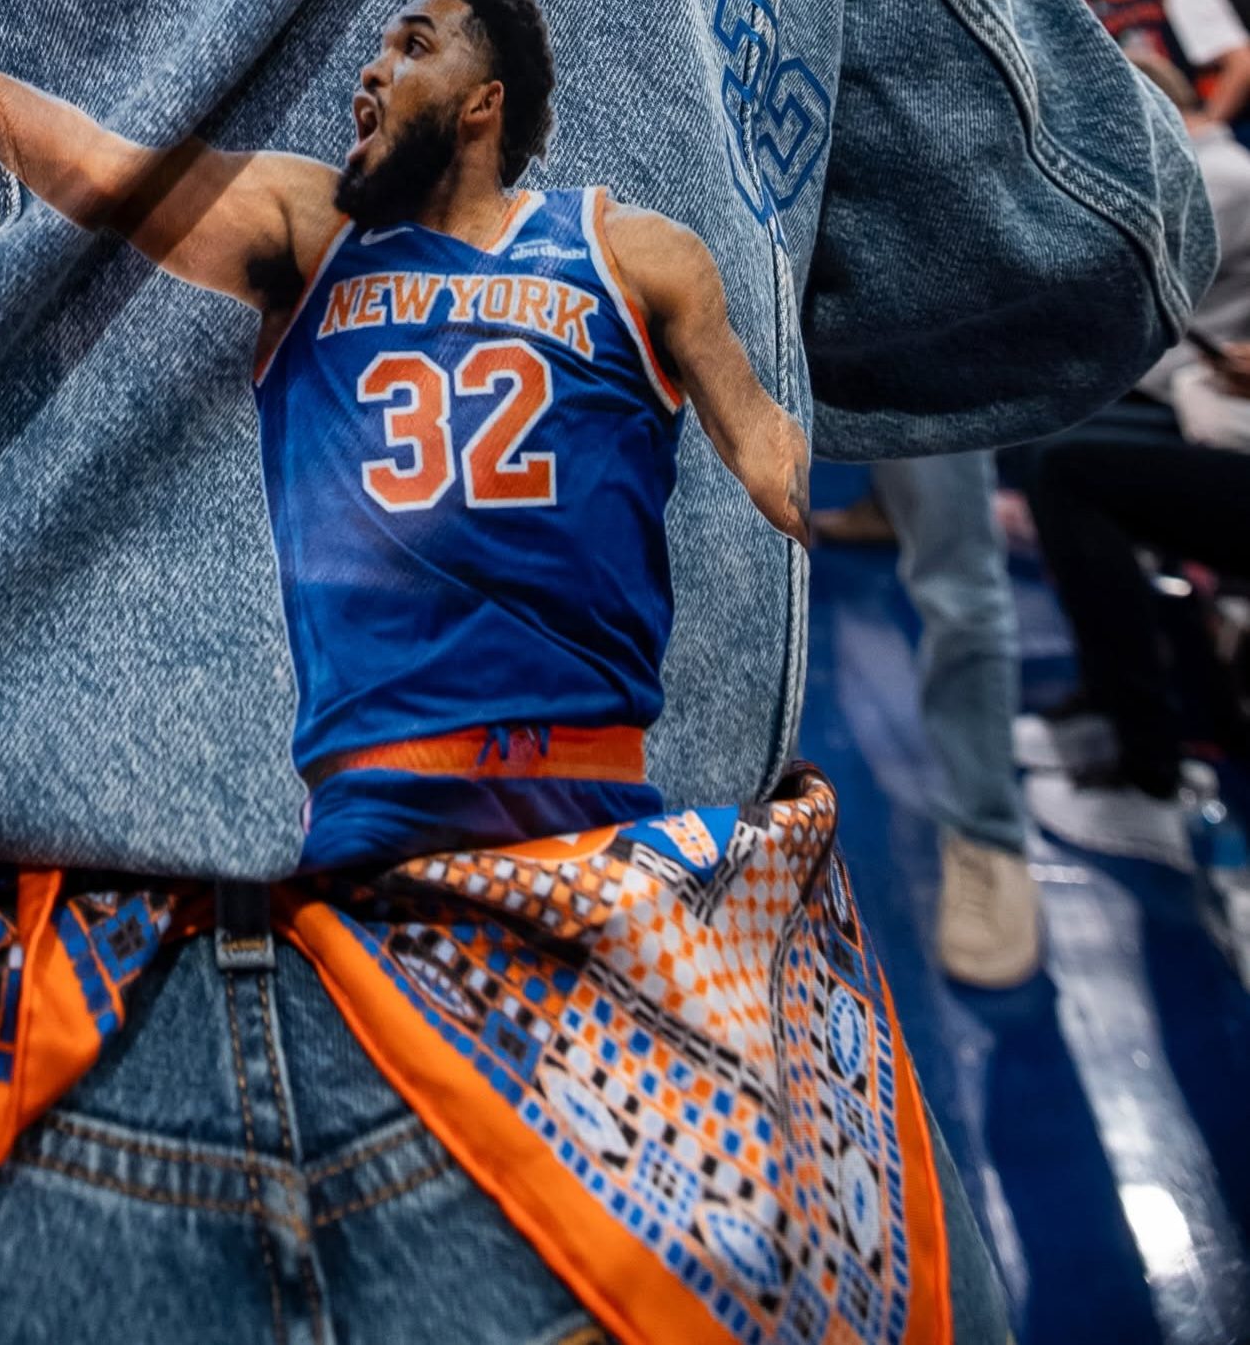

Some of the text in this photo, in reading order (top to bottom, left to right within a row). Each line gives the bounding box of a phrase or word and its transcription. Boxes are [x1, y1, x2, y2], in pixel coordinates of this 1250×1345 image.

[317, 271, 599, 362] NEW YORK
[357, 338, 557, 513] 32
